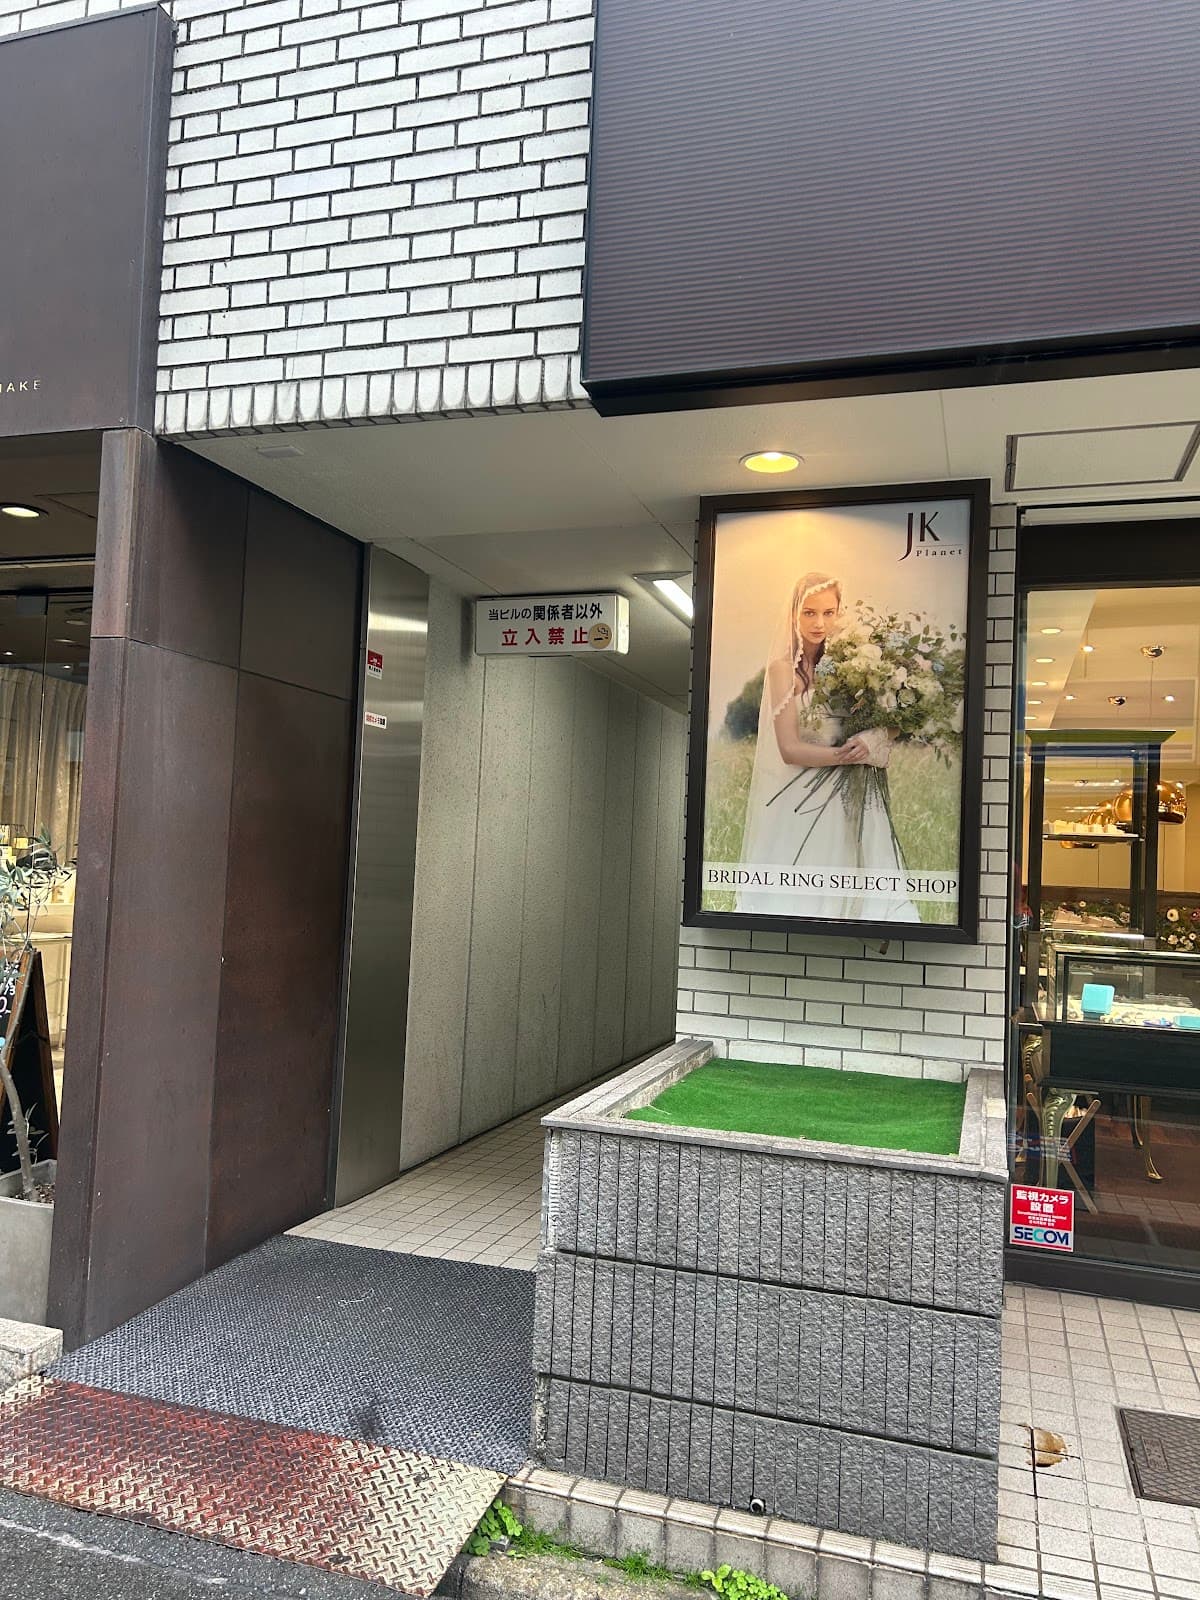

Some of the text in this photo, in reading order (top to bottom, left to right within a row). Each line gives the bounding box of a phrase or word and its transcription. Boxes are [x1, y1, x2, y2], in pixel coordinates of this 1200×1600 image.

[0, 380, 41, 393] AKE
[897, 512, 940, 561] JK
[916, 549, 962, 557] Planet
[488, 603, 602, 621] 当ビルの関係者以外
[501, 627, 588, 646] 立入禁止
[708, 869, 957, 894] BRIDAL RING SELECT SHOP
[1016, 1190, 1069, 1205] 監視カメラ
[1030, 1201, 1054, 1213] 設置
[1014, 1226, 1069, 1246] SECOM
